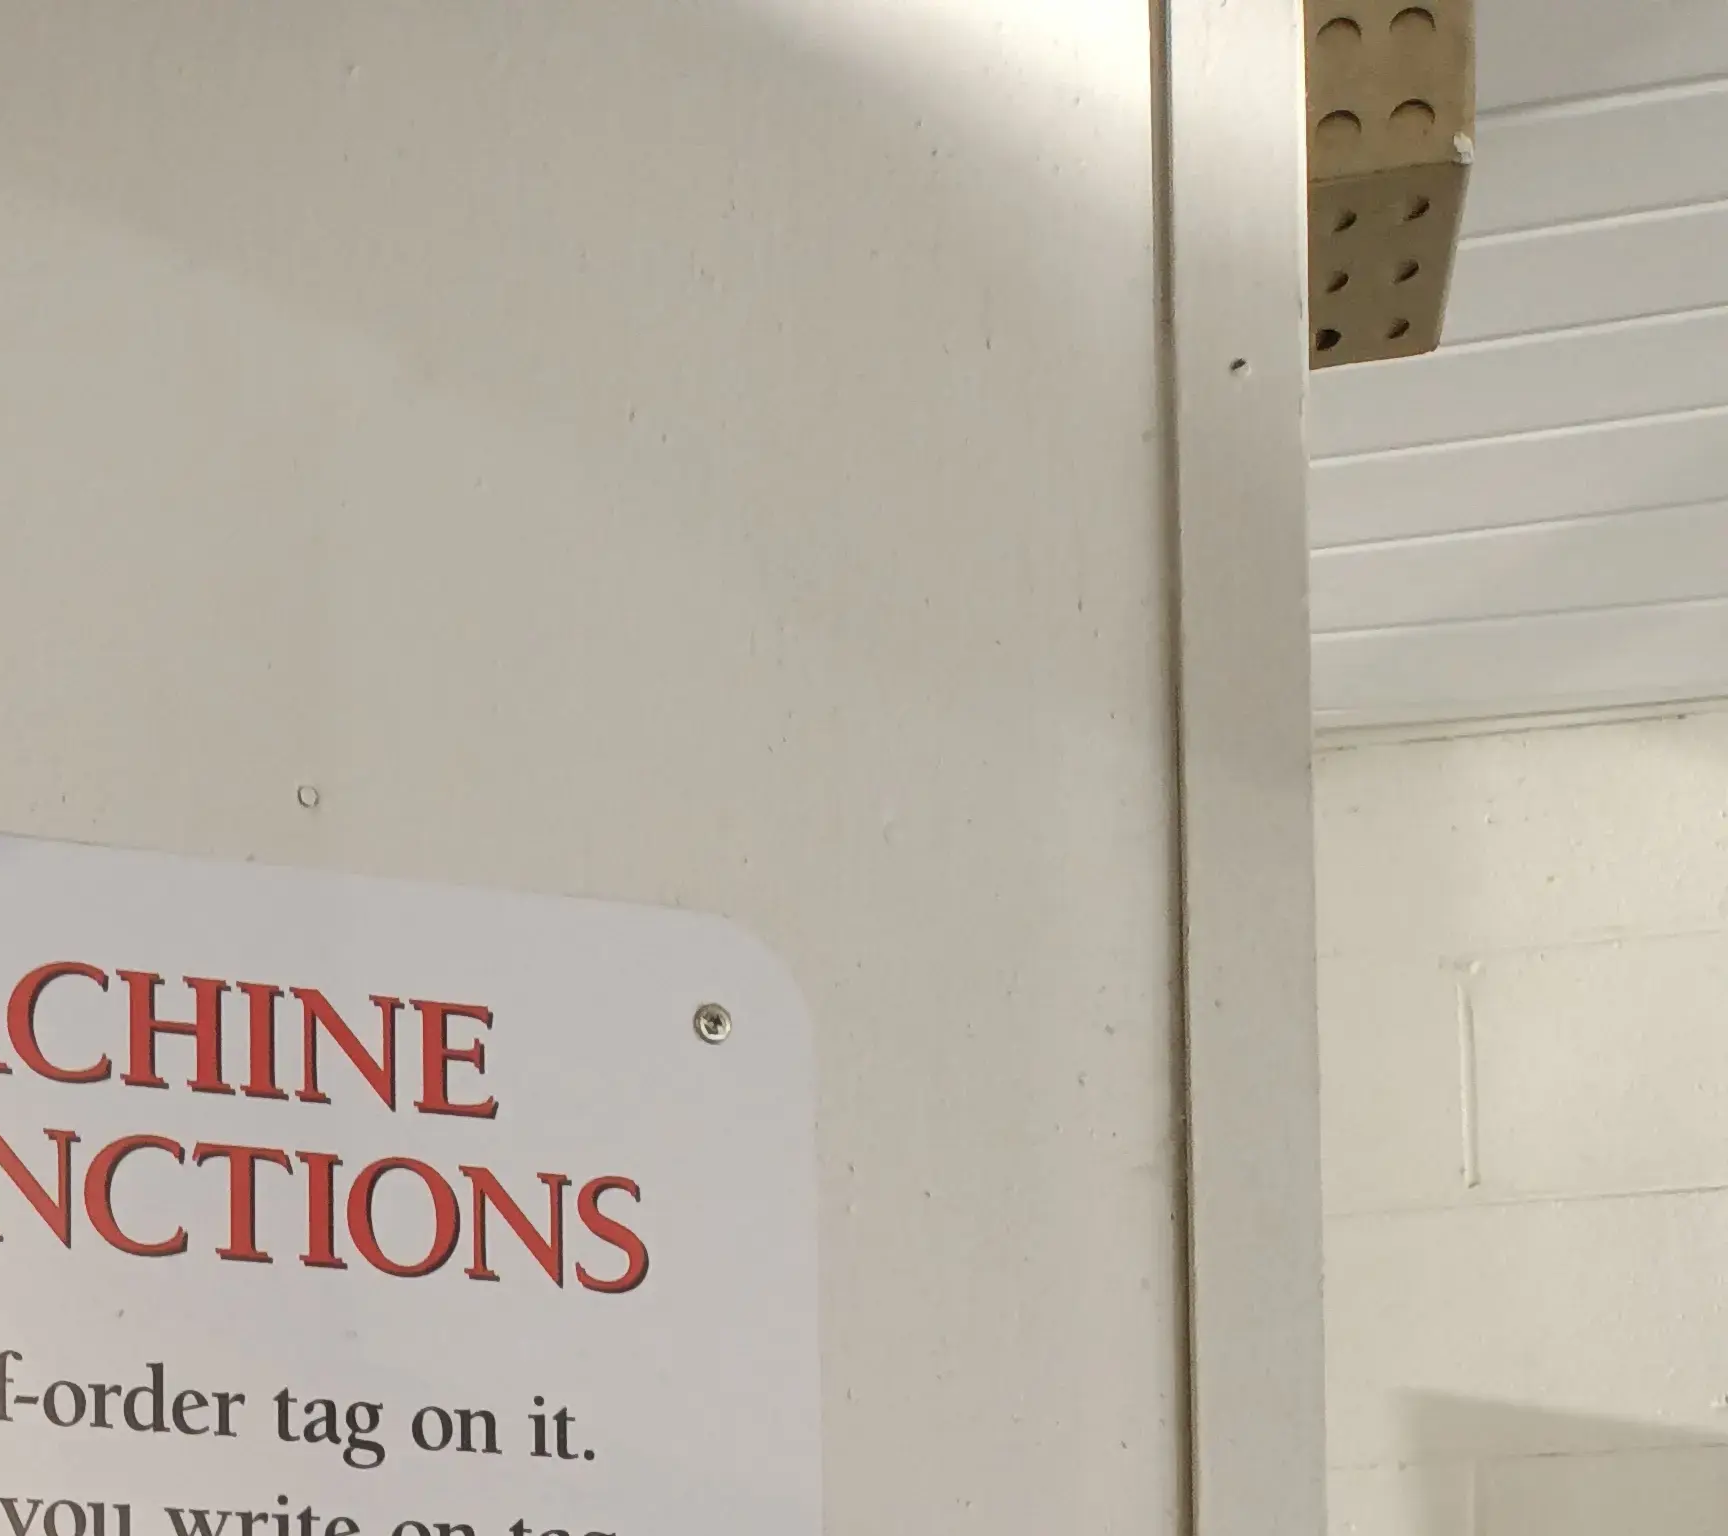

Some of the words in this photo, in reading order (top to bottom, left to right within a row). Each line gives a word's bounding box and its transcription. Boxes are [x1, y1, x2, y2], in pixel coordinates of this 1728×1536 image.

[274, 1388, 385, 1469] tag
[412, 1406, 502, 1454] on
[528, 1396, 594, 1460] it.
